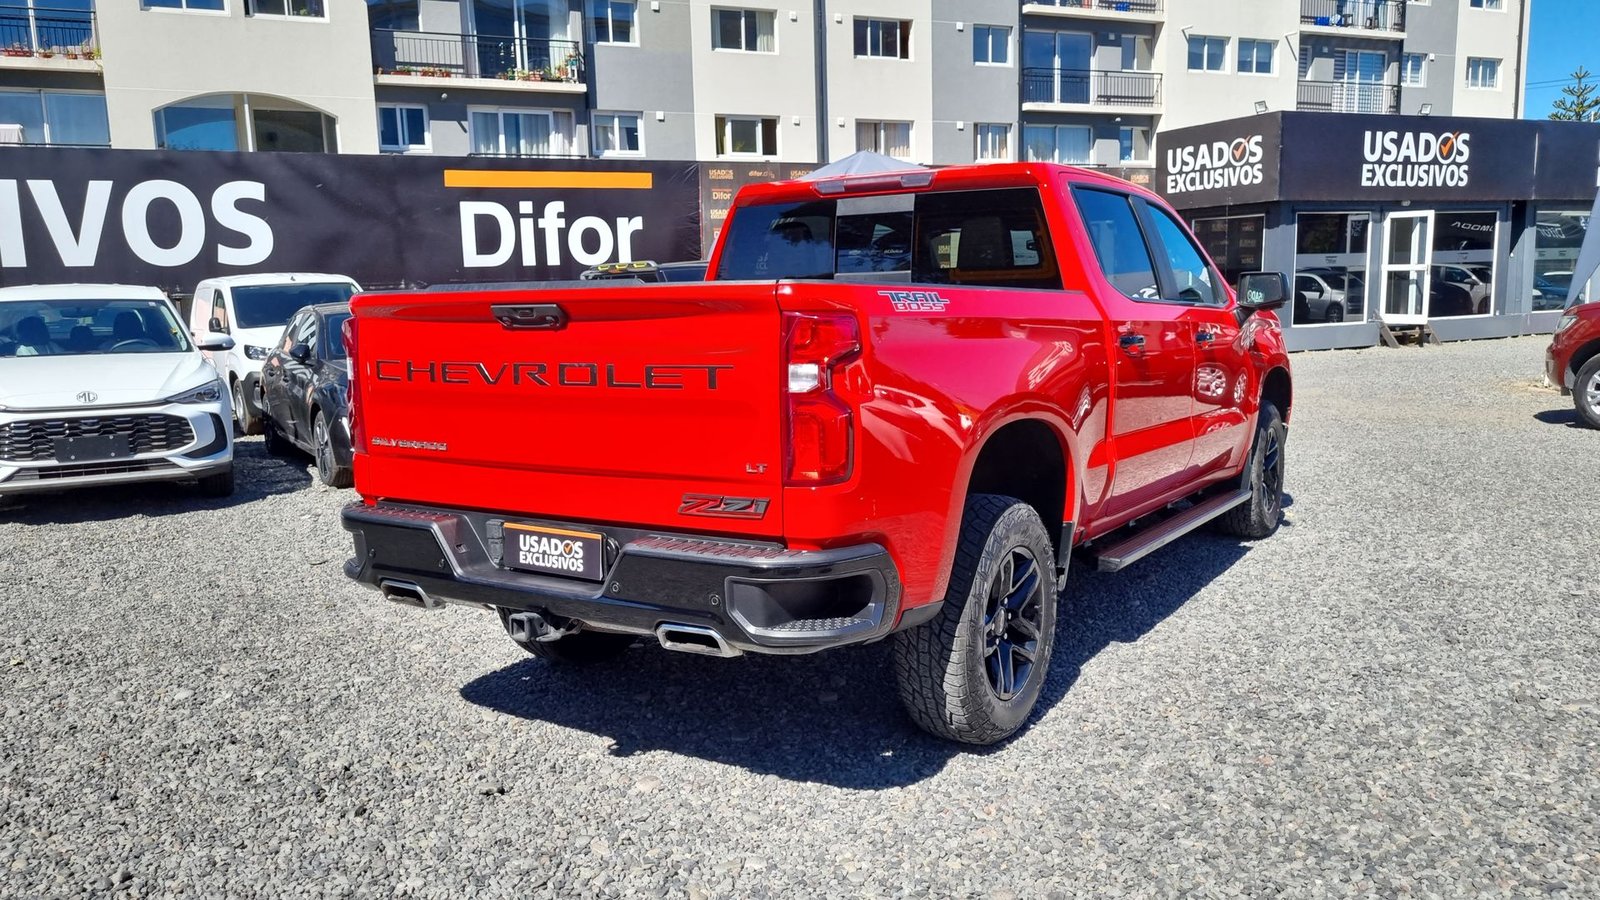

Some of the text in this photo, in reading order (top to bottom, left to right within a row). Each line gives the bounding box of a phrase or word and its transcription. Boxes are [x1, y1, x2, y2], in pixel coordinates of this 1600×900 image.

[1167, 135, 1263, 174] USADOS
[1363, 130, 1470, 164] USADOS
[1167, 163, 1263, 194] EXCLUSIVOS
[1361, 163, 1469, 187] EXCLUSIVOS
[712, 191, 732, 200] Difor
[0, 179, 274, 268] IVOS
[459, 200, 643, 268] Difor
[877, 291, 950, 303] TRAIL
[892, 302, 946, 312] BOSS
[376, 360, 734, 389] CHEVROLET
[76, 391, 98, 403] MG
[745, 463, 768, 473] LT
[678, 493, 770, 520] Z71
[519, 534, 584, 559] USADOS
[519, 550, 584, 572] EXCLUSIVOS
